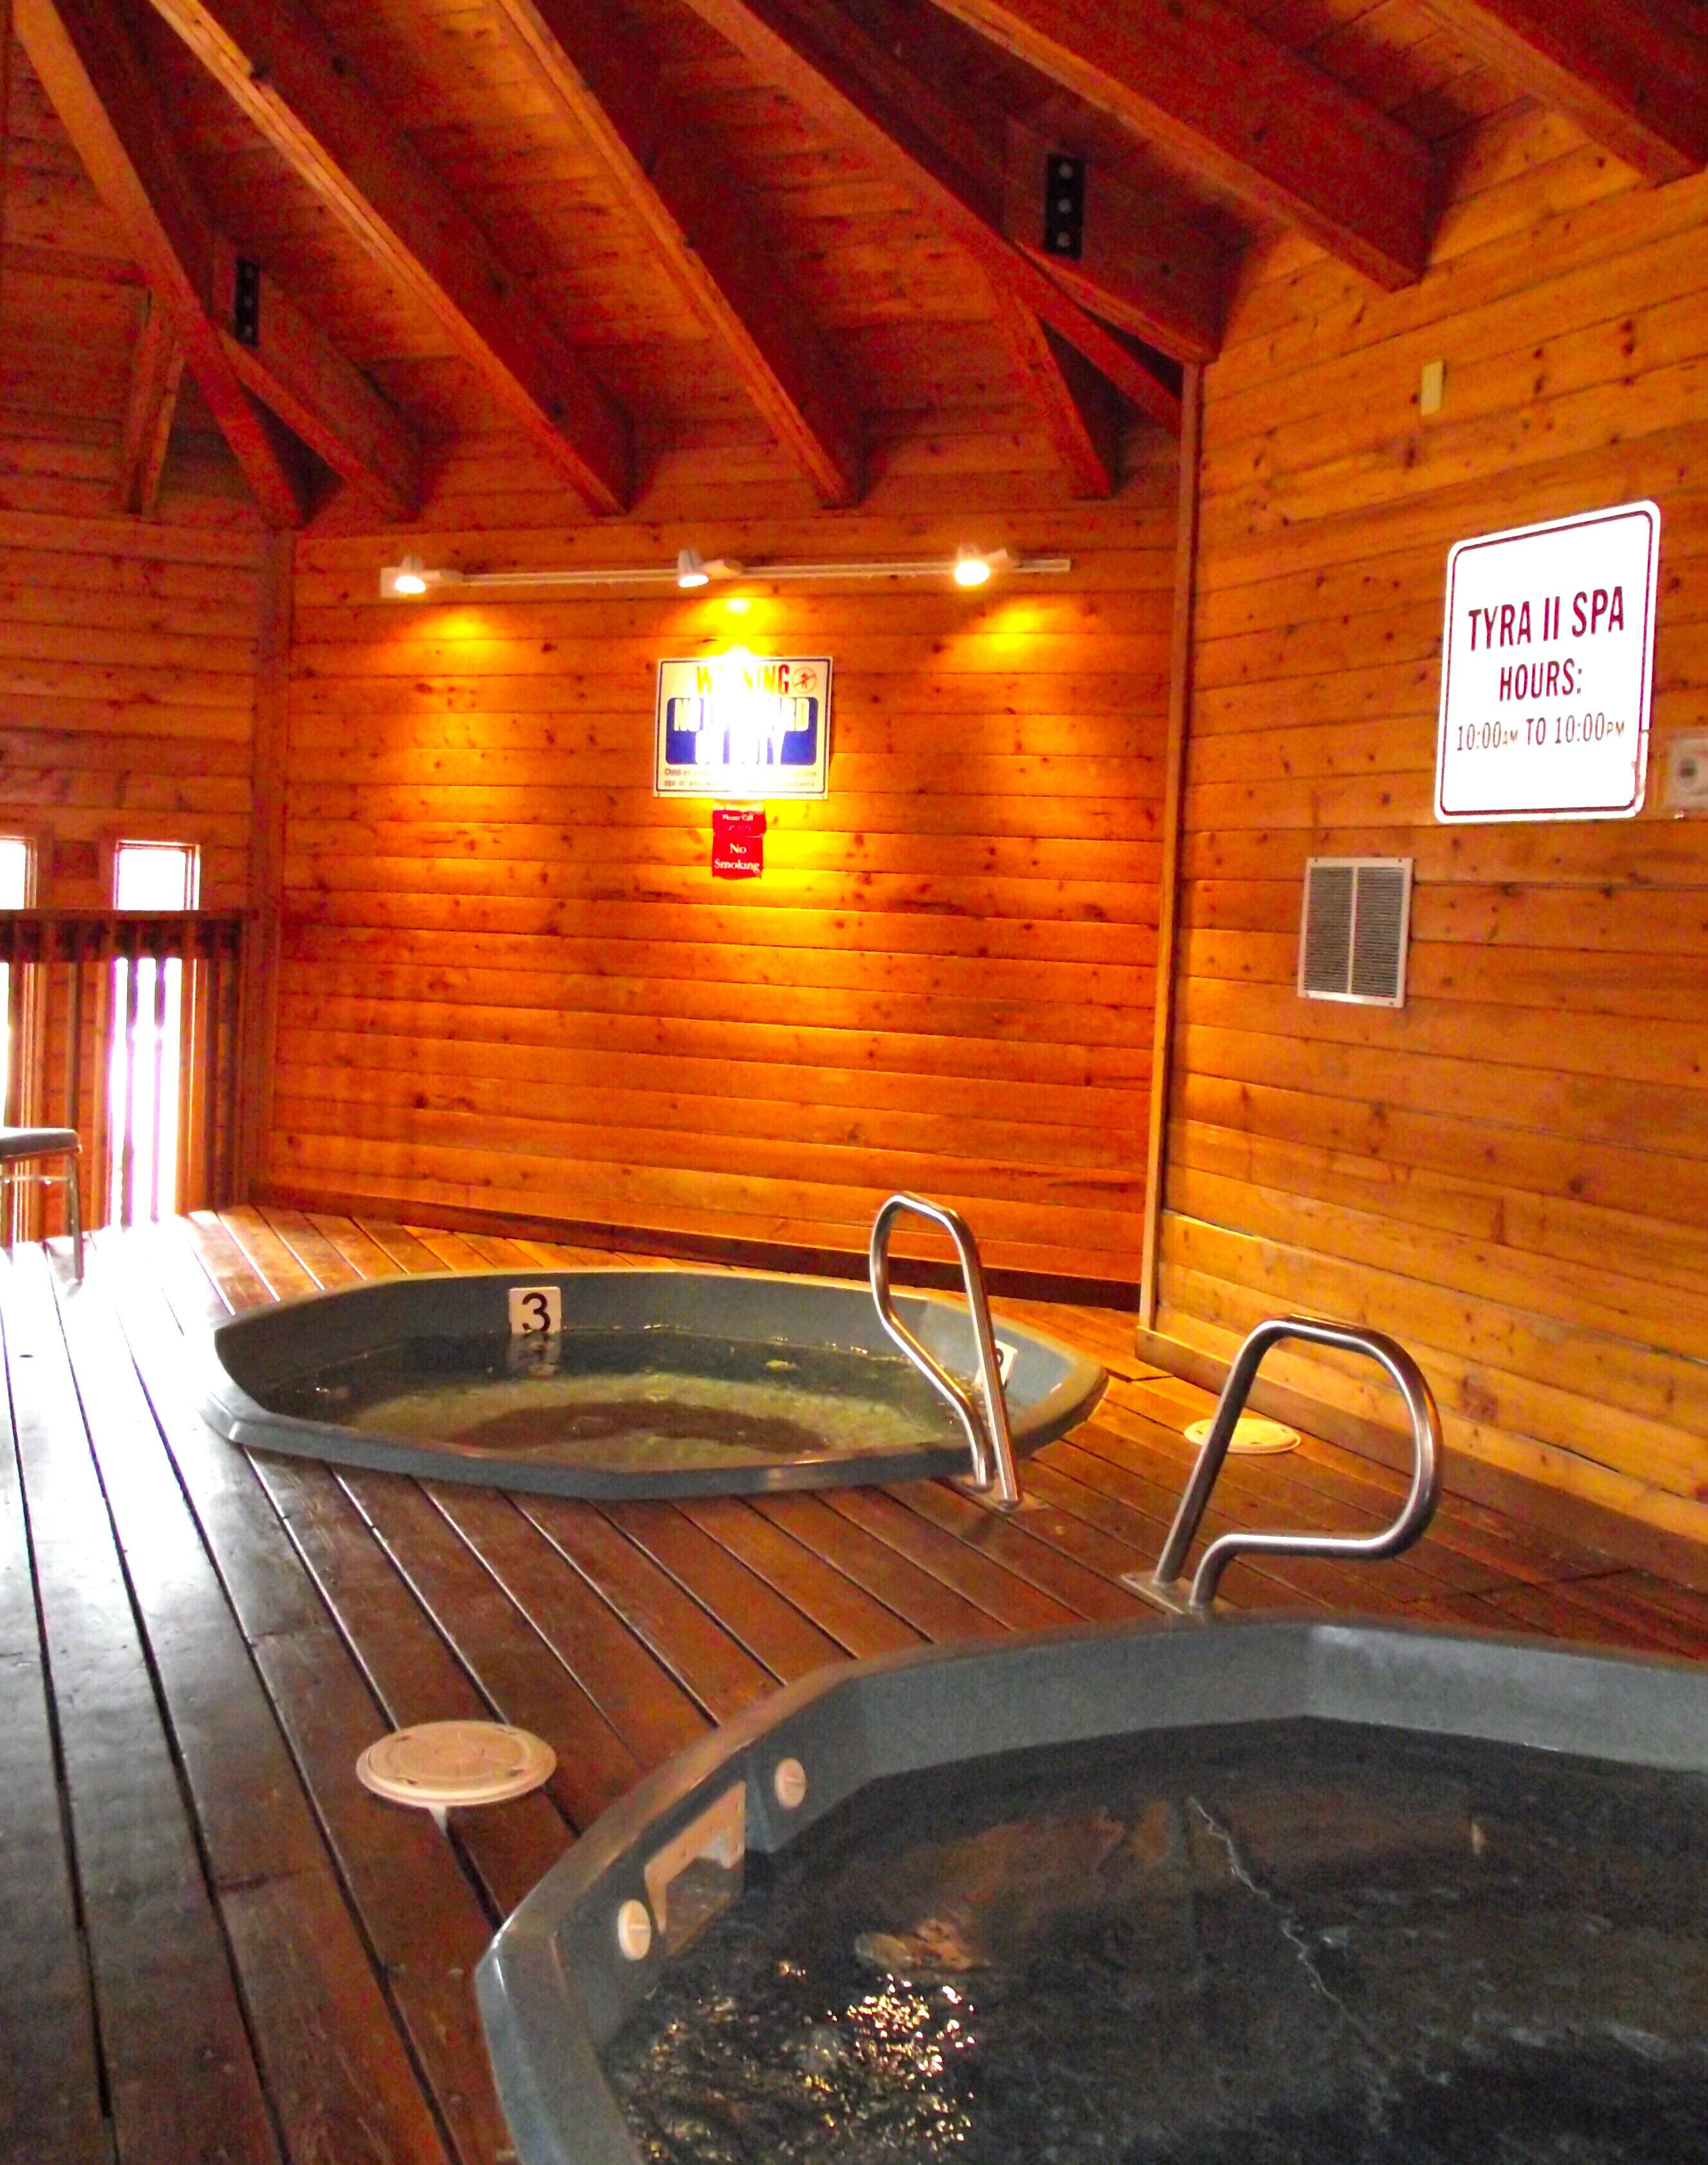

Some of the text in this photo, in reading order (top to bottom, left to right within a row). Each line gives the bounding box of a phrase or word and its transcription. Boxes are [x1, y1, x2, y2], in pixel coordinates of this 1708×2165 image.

[1468, 586, 1624, 652] TYRA II SPA
[1499, 658, 1583, 702] HOURS:
[1526, 718, 1546, 745] TO
[729, 843, 747, 854] No
[714, 859, 761, 874] Smoking
[522, 1292, 551, 1332] 3
